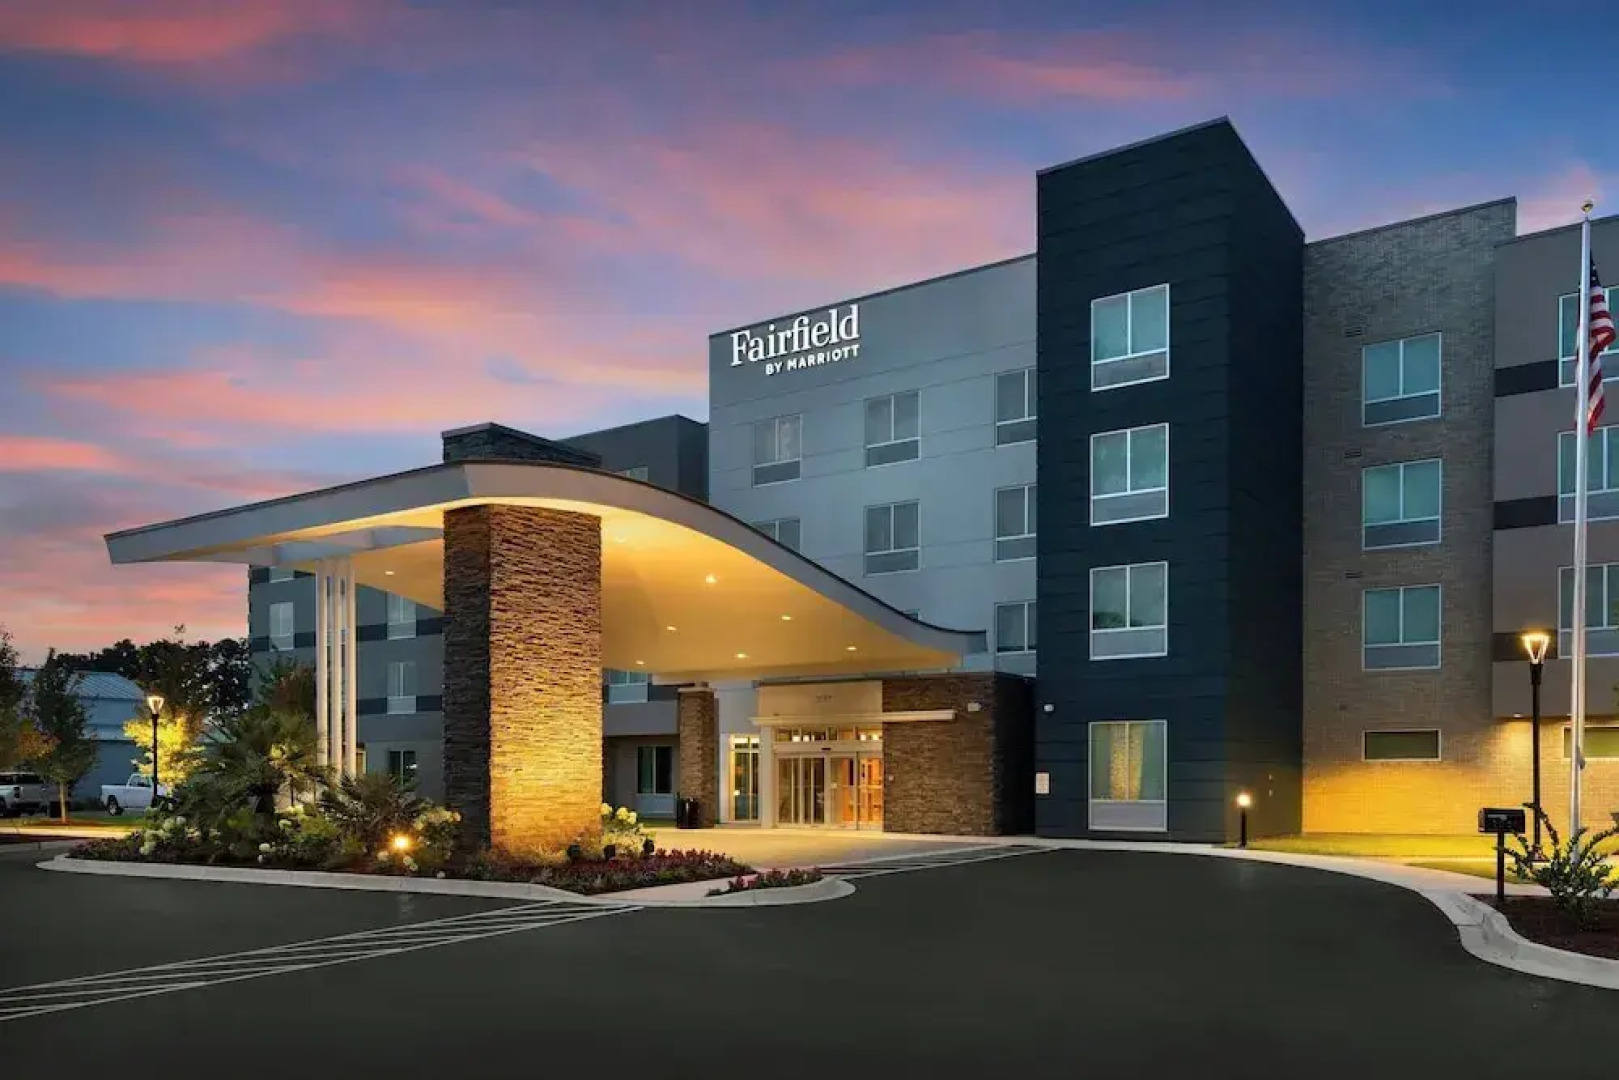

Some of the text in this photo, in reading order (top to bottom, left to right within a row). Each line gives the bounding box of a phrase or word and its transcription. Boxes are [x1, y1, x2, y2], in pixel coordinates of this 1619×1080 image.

[730, 304, 860, 367] Fairfield
[765, 344, 860, 375] BY MARRIOTT
